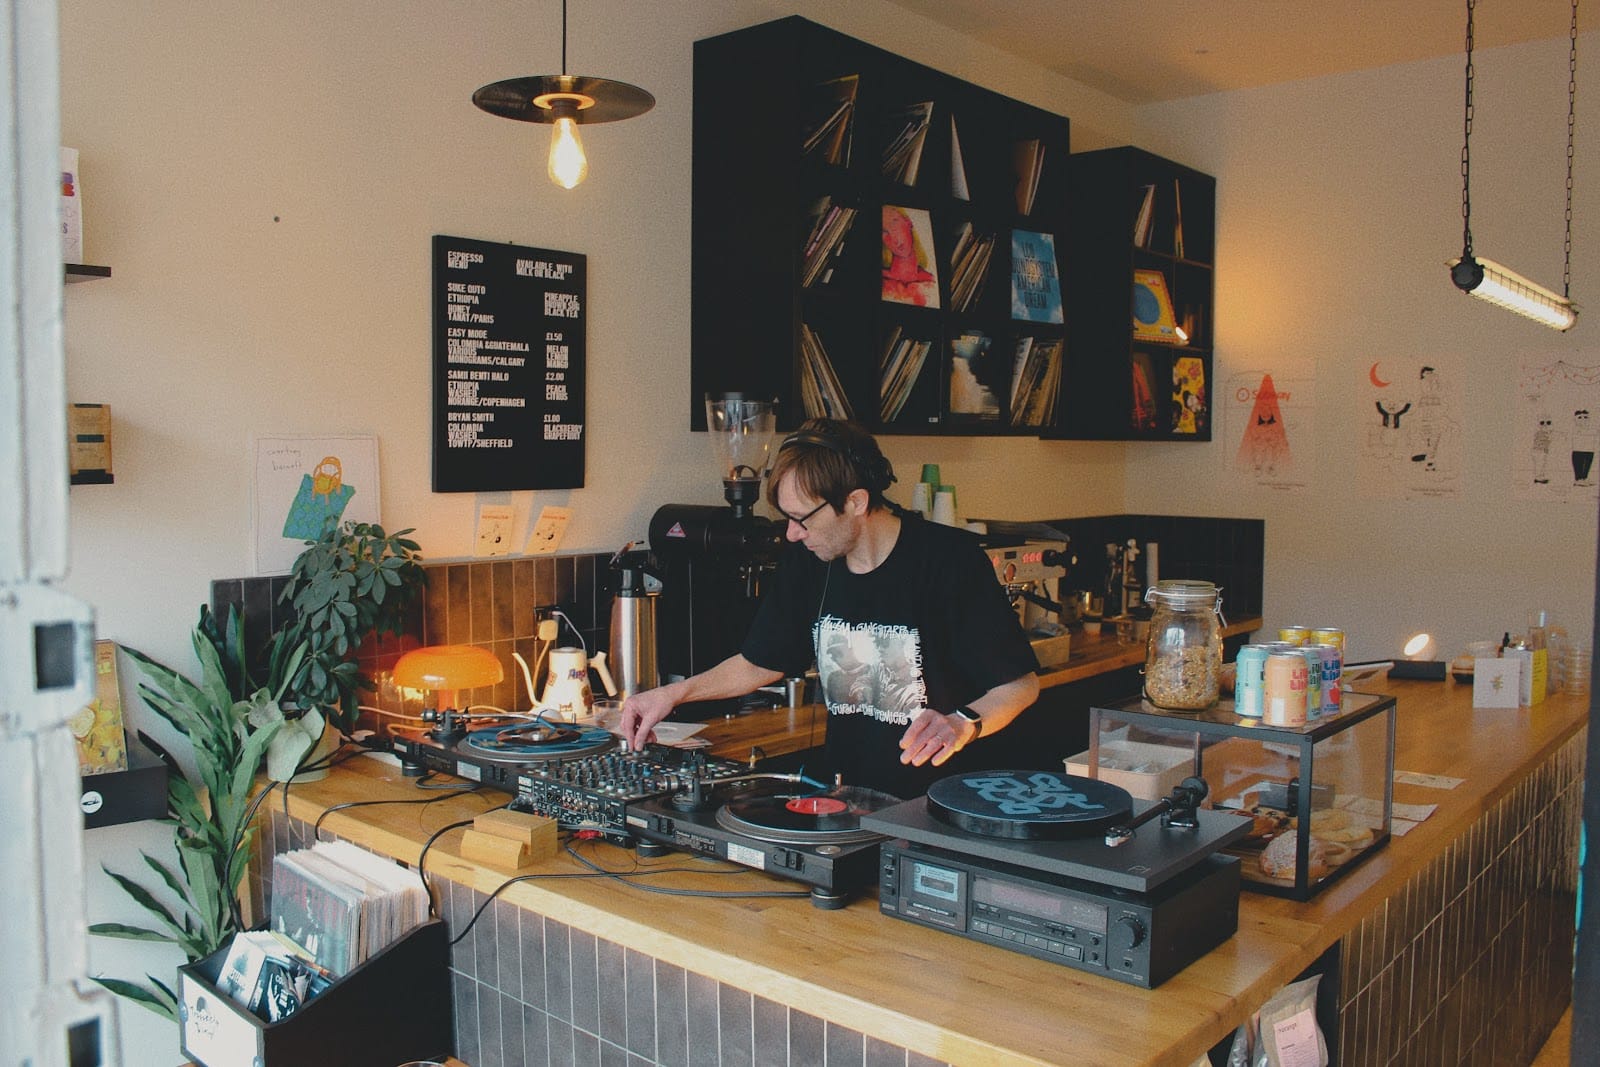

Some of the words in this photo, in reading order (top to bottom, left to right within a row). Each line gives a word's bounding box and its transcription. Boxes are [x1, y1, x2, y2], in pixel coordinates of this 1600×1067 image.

[447, 250, 484, 263] ESPRESSO
[447, 259, 469, 270] MENU
[516, 259, 553, 271] AVAILABLE
[556, 263, 573, 274] WITH
[516, 267, 533, 277] MILK
[544, 269, 565, 280] BLACK
[447, 282, 466, 293] SUKE
[447, 293, 479, 305] ETHIOPIA
[544, 292, 578, 302] PINEAPPLE
[447, 303, 471, 314] HONEY
[544, 308, 565, 318] BLACK
[566, 309, 578, 319] TEA
[447, 327, 466, 338] EASY
[467, 329, 488, 339] MODE
[447, 338, 484, 349] COLOMBIA
[545, 372, 565, 381] £2.00
[447, 380, 480, 391] ETHIOPIA
[546, 384, 567, 393] PEACH
[447, 389, 477, 398] WASHED
[546, 392, 568, 401] CITRUS
[447, 412, 471, 422] BRYAN
[471, 413, 495, 422] SMITH
[447, 423, 484, 433] COLOMBIA
[544, 424, 583, 433] BLACKBERRY
[447, 431, 477, 440] WASHED
